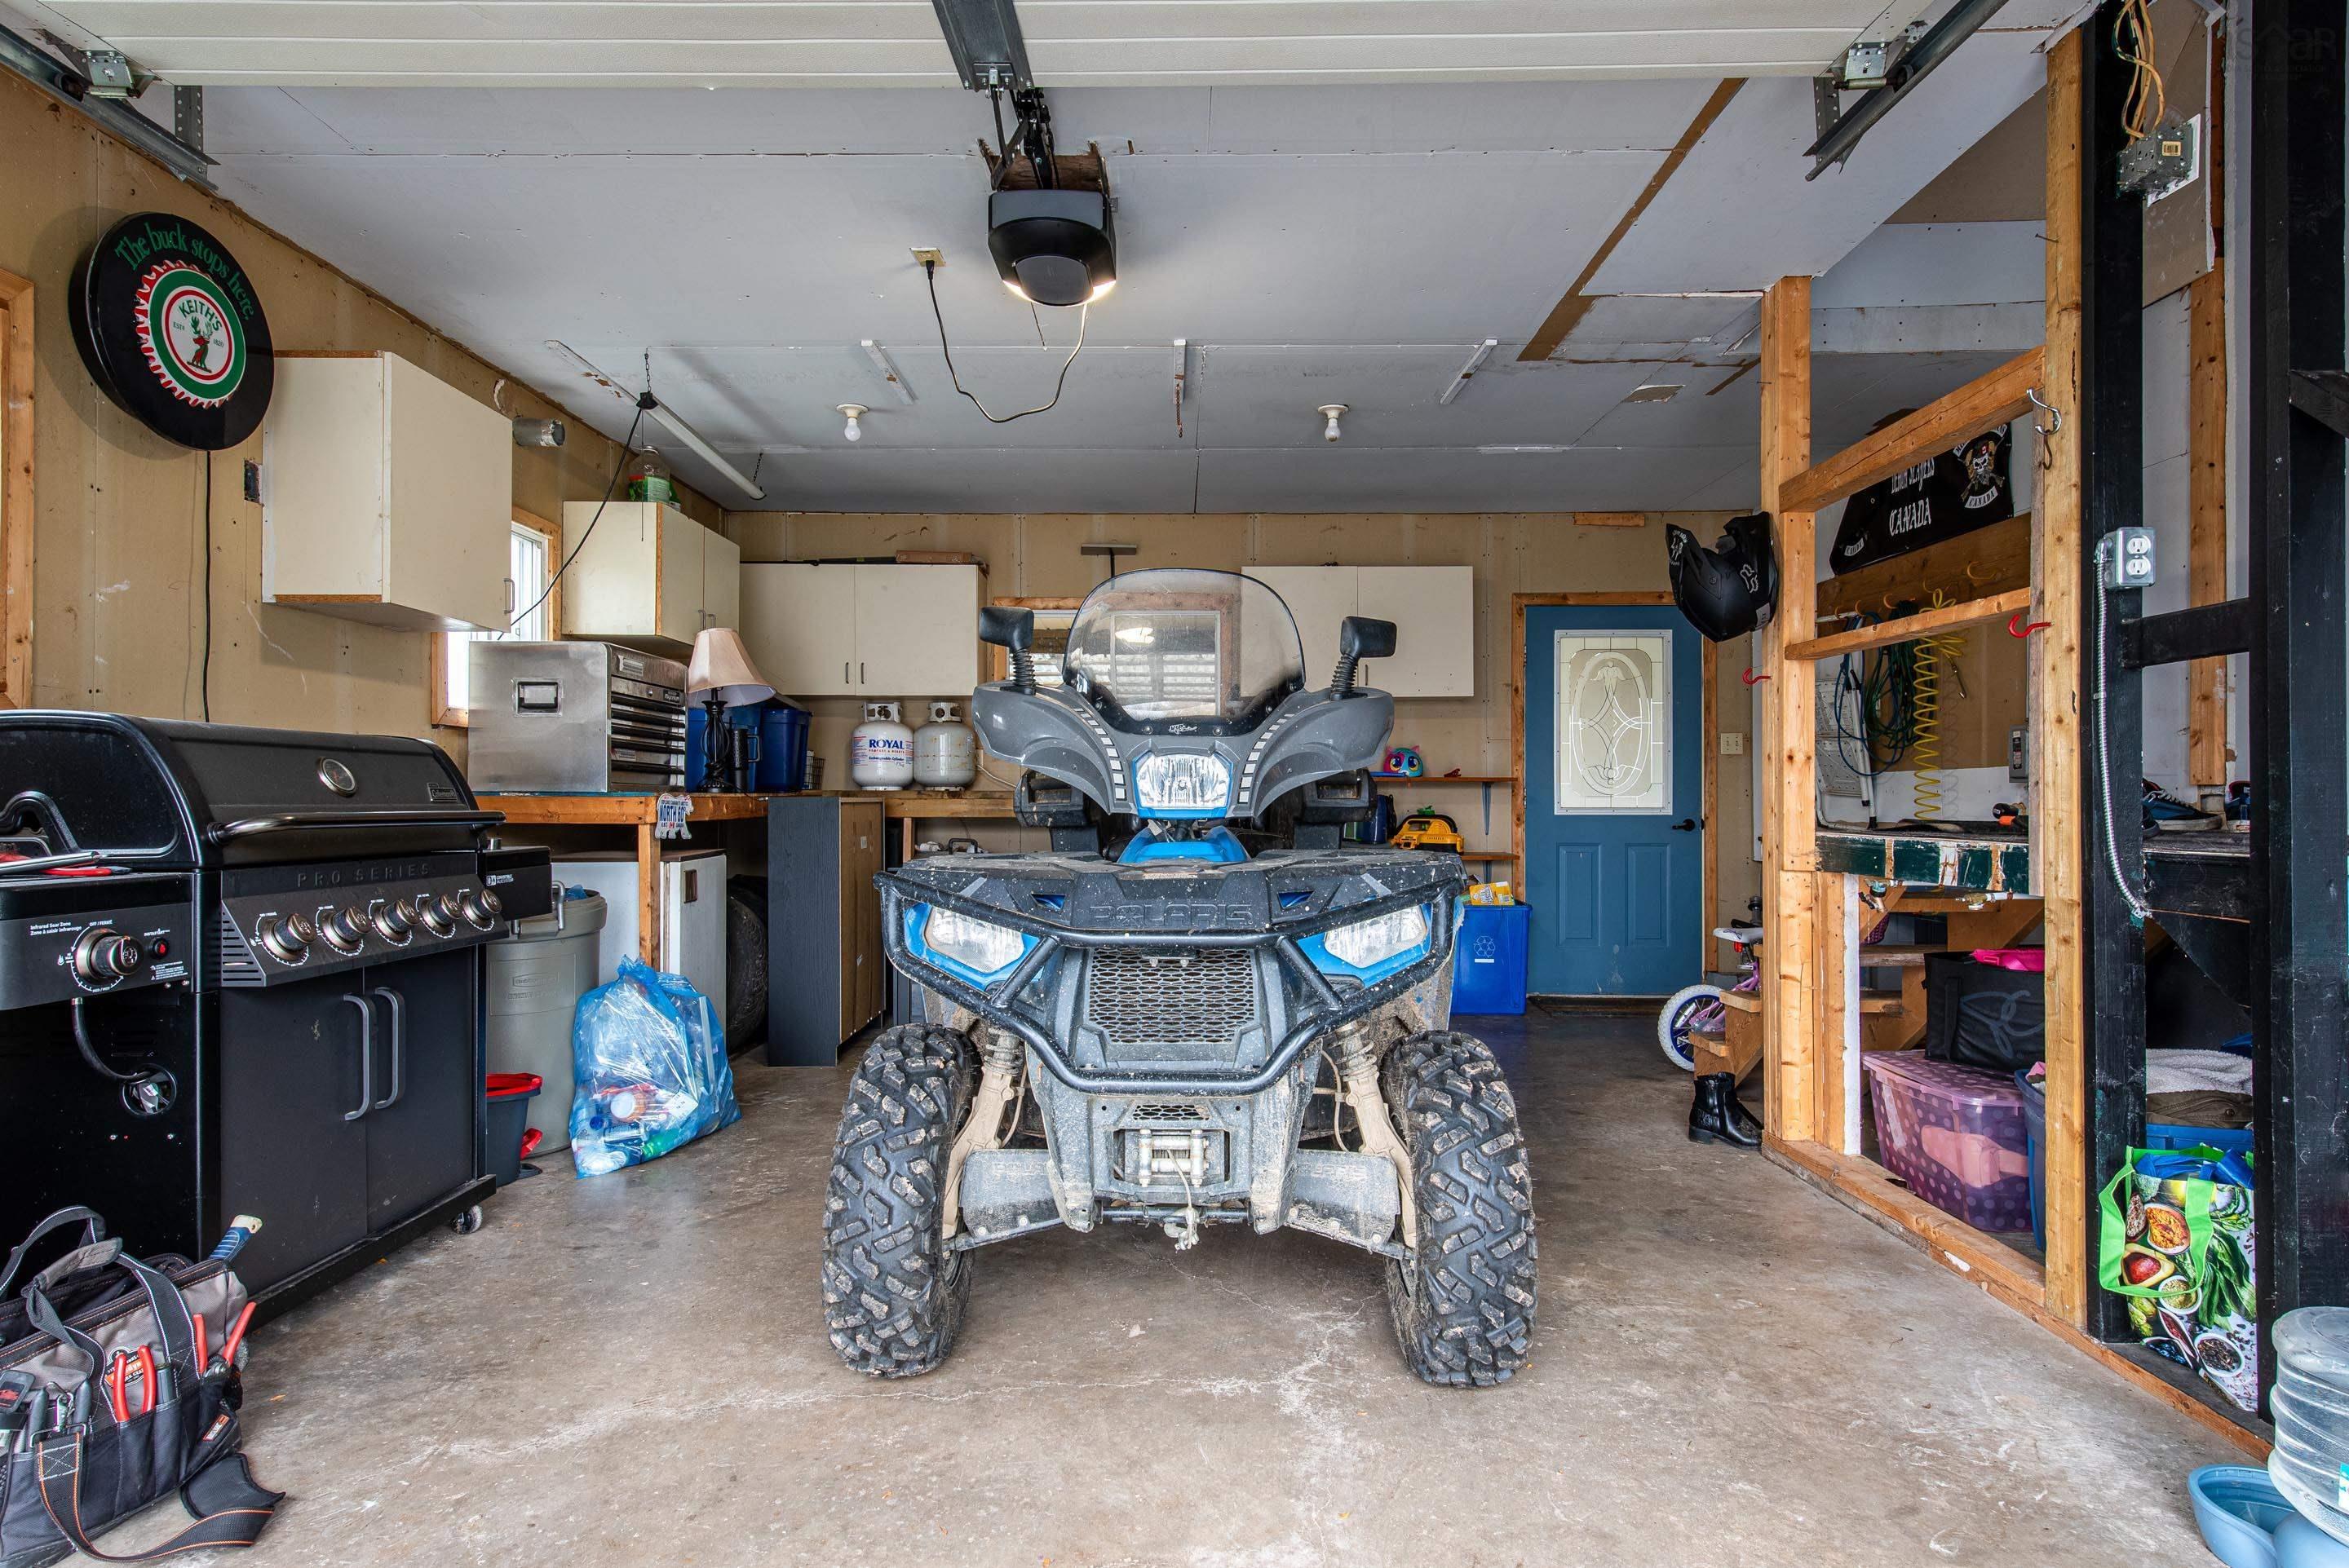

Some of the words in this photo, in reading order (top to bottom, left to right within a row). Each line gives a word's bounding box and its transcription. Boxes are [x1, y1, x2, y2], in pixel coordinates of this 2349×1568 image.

[115, 236, 150, 271] The
[144, 222, 188, 252] buck
[191, 238, 230, 279] stops
[178, 299, 223, 331] KEITH'S
[1968, 490, 1995, 507] CANADA
[1889, 497, 1931, 537] CANADA
[869, 739, 905, 750] ROYAL
[659, 804, 677, 822] NORTH
[297, 870, 341, 887] PRO
[355, 863, 430, 882] SERIES
[1089, 903, 1254, 928] POLARIS
